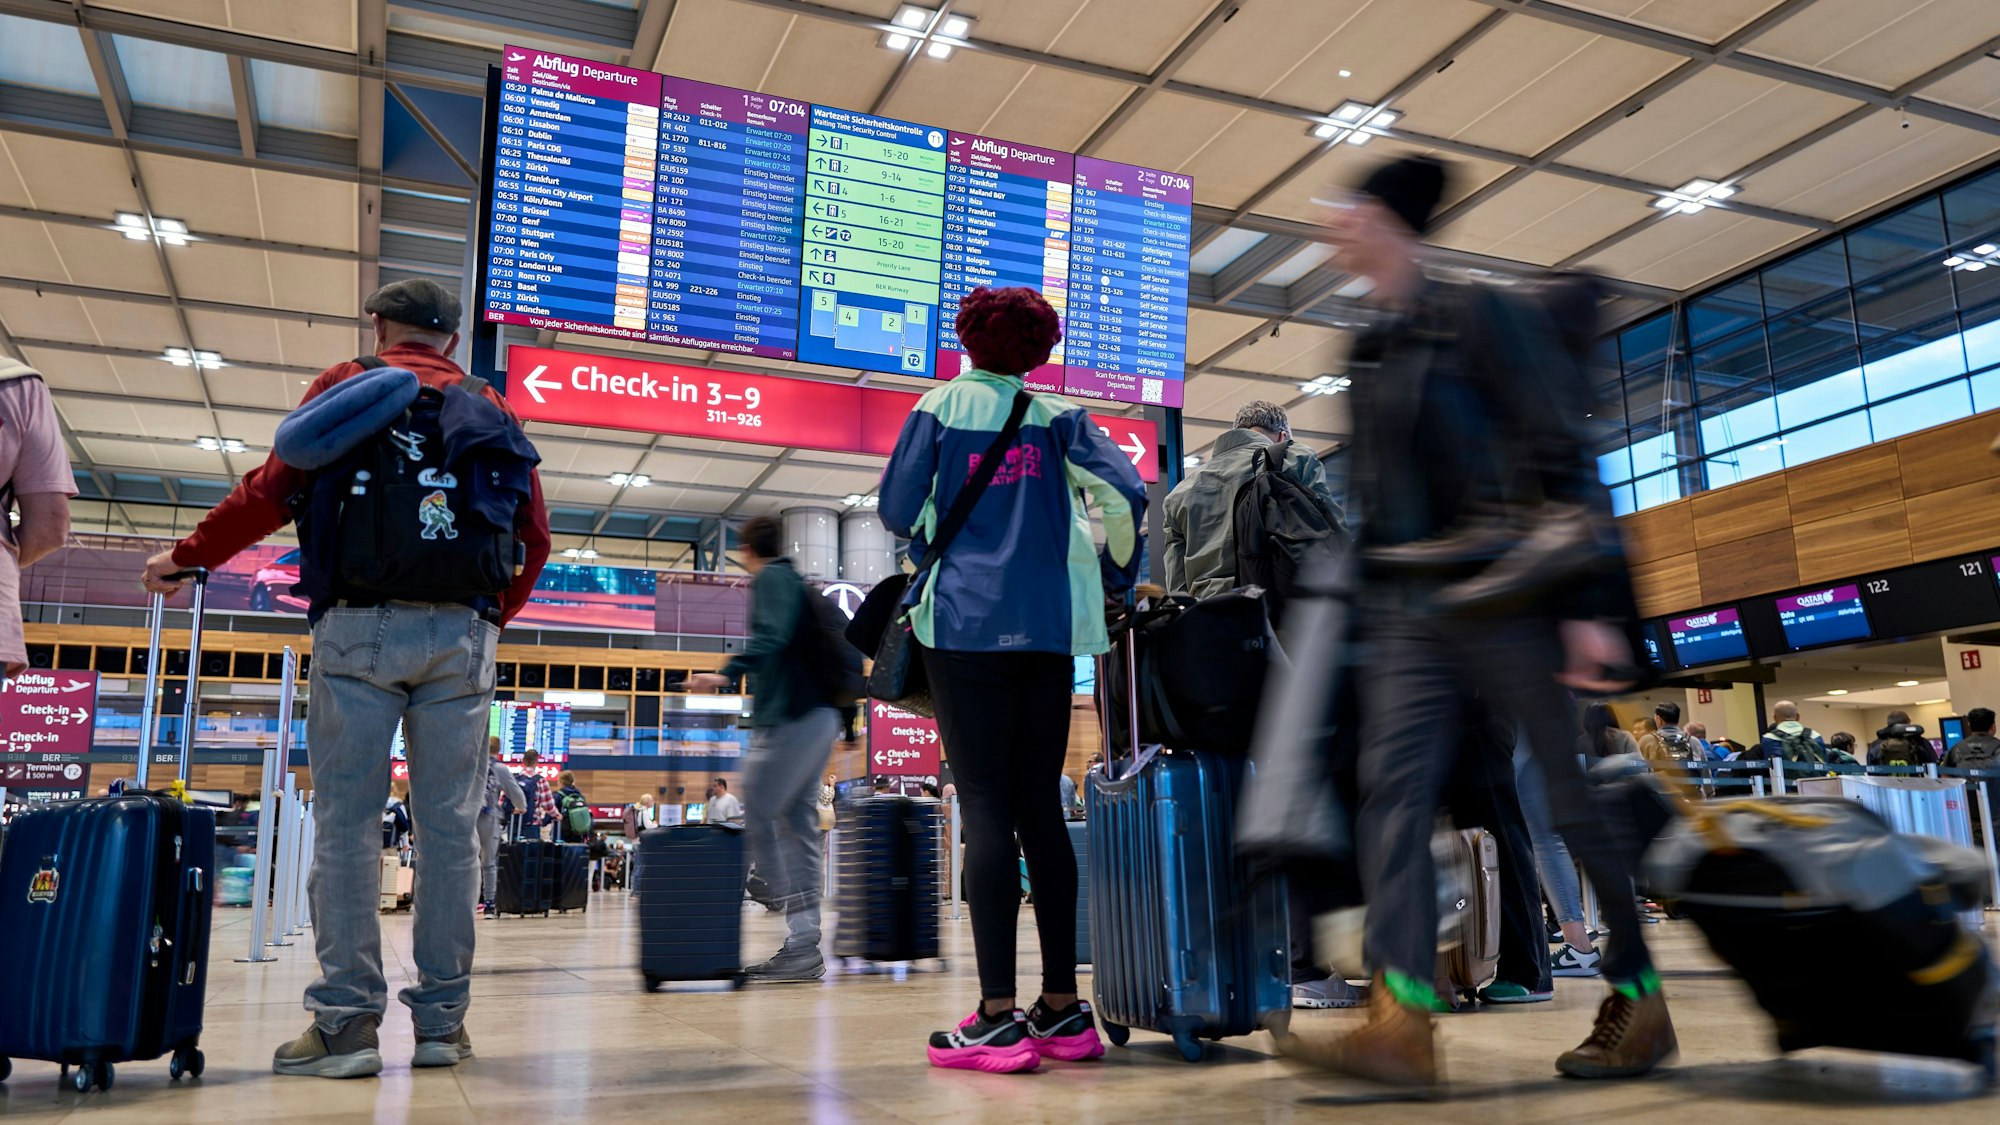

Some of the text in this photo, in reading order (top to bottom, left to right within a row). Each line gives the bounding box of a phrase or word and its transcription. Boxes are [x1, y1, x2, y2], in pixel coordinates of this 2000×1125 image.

[533, 54, 638, 86] Abflug Departure
[505, 82, 792, 141] 05:20 Palma de Mallorca SR 2412 011-012 Erwartet 07:20
[743, 94, 748, 106] 1
[769, 99, 806, 117] 07:04
[503, 115, 560, 131] 06:00 Lissabon
[504, 93, 792, 152] 06:00 Venedig FR 401 Erwartet 07:20
[814, 108, 923, 136] Wartezeit Sicherheitskontrolle
[502, 125, 552, 141] 06:10 Dublin
[504, 104, 791, 162] 06:00 Amsterdam KL 1770 811-816 Erwartet 07:45
[813, 118, 897, 139] Waiting Time Security Control
[501, 136, 562, 153] 06:15 Paris CDG
[845, 142, 849, 150] 1
[500, 147, 571, 165] 06:25 Thessaloniki
[971, 139, 1055, 166] Abflug Departure
[525, 162, 549, 172] Zürich
[843, 164, 849, 174] 2
[525, 173, 560, 185] Frankfurt
[949, 174, 997, 189] 07:25 Frankfurt
[1137, 170, 1190, 190] 2 07:04
[524, 184, 593, 202] London City Airport
[842, 187, 848, 195] 4
[523, 195, 563, 208] Köln/Bonn
[523, 206, 550, 216] Brüssel
[841, 210, 847, 218] 5
[522, 216, 540, 226] Genf
[521, 227, 555, 239] Stuttgart
[841, 231, 850, 242] T2
[520, 238, 540, 248] Wien
[946, 243, 982, 254] 08:00 Wien
[520, 249, 555, 262] Paris Orly
[518, 260, 563, 273] London LHR
[876, 261, 898, 270] Priority
[518, 271, 551, 283] Rom FCO
[517, 282, 538, 292] Basel
[516, 293, 540, 303] Zürich
[821, 296, 827, 306] 5
[516, 304, 550, 316] München
[914, 310, 918, 319] 1
[845, 312, 852, 321] 4
[888, 317, 895, 327] 2
[488, 312, 755, 353] BER Von jeder Sicherheitskontrolle sind sämtliche Abfluggates erreichbar.
[909, 354, 919, 365] T2
[572, 366, 760, 411] Check-in 3–9
[1107, 381, 1136, 390] Departures
[1080, 388, 1103, 398] Baggage
[707, 410, 761, 426] 311–926
[1959, 561, 1982, 577] 121
[1867, 580, 1890, 594] 122
[1797, 594, 1823, 605] QATAR
[1686, 616, 1708, 627] QATAR
[16, 674, 54, 687] Abflug
[16, 685, 59, 694] Departure
[21, 704, 69, 714] Check-in
[9, 732, 59, 742] Check-in
[892, 727, 924, 736] Check-in
[887, 750, 920, 758] Check-in
